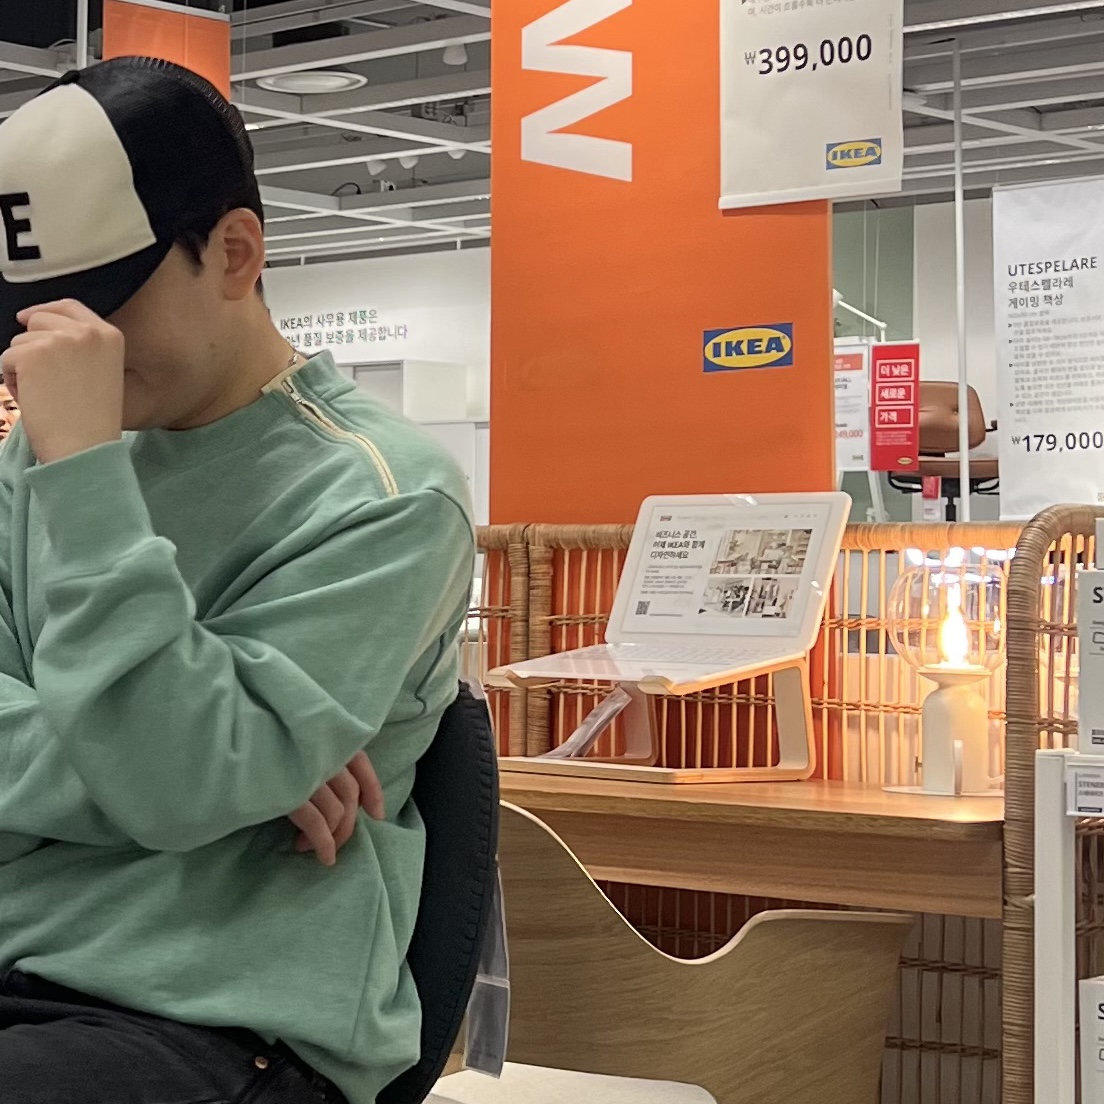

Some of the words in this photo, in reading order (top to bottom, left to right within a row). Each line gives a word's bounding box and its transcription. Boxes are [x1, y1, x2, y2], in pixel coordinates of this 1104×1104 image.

[831, 146, 878, 161] IKEA
[1008, 256, 1097, 276] UTESPELARE
[1008, 296, 1039, 309] 게이밍
[1043, 293, 1064, 306] 책상
[280, 315, 312, 330] IKEA의
[316, 312, 344, 327] 사무용
[348, 309, 377, 325] 제품은
[304, 331, 322, 346] 품질
[357, 324, 408, 342] 제공합니다
[712, 336, 785, 358] IKEA
